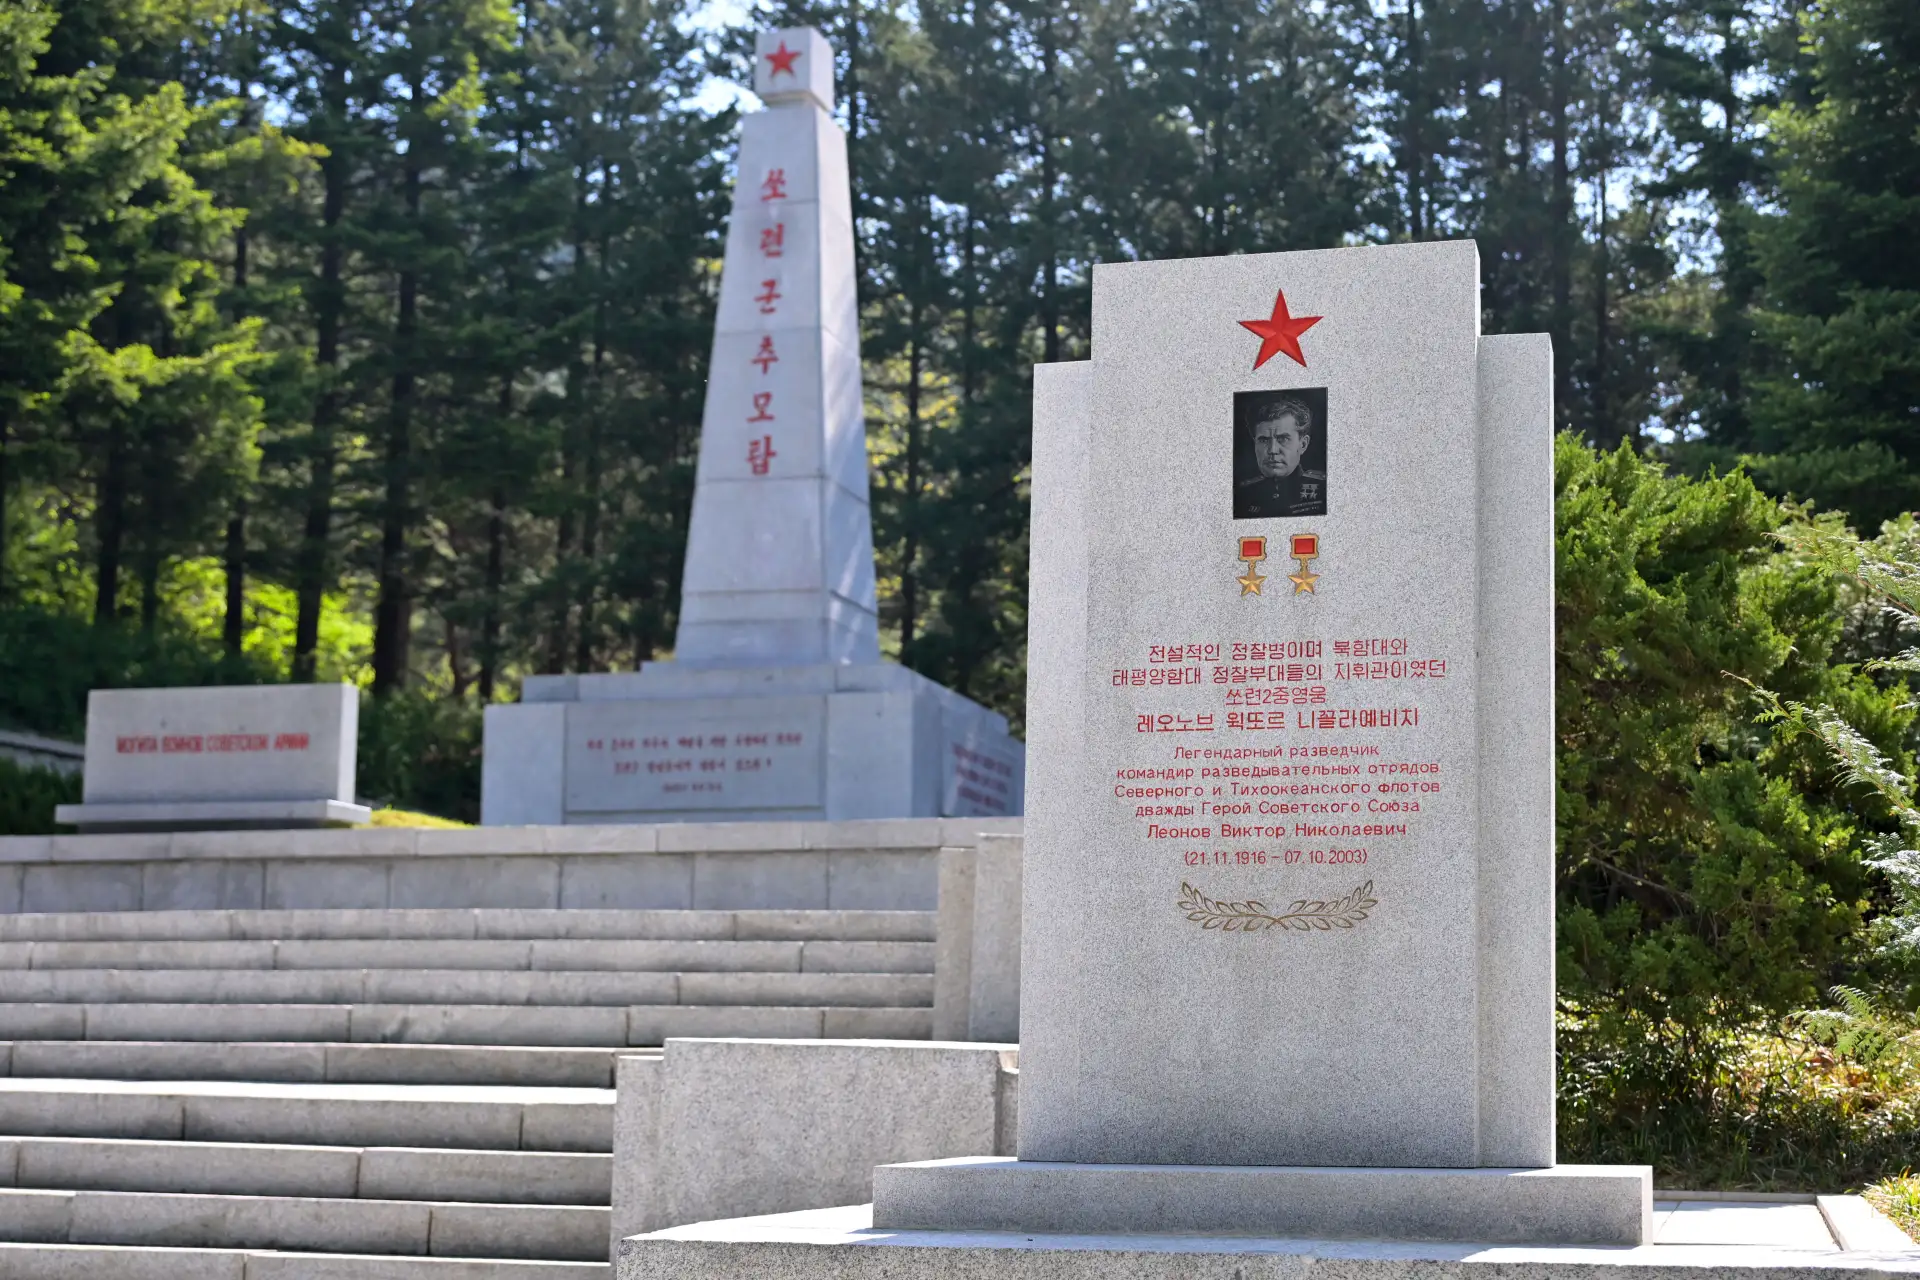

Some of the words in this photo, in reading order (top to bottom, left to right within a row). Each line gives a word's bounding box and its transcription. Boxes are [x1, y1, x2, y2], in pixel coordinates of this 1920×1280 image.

[1148, 643, 1220, 663] 전설적인
[1231, 639, 1322, 661] 정찰병이며
[1332, 637, 1408, 657] 북함대와
[1112, 666, 1201, 686] 태평양함대
[1212, 663, 1323, 686] 정찰부대들의
[1334, 658, 1446, 680] 지휘관이였던
[1224, 685, 1328, 706] 쏘련2중영웅
[1136, 712, 1214, 733] 레오노브
[1297, 707, 1419, 729] 니꼴라예비치
[1173, 745, 1283, 760] Легендарный
[1288, 745, 1379, 758] разведчик
[1116, 767, 1194, 780] командир
[1201, 764, 1360, 778] разведывательных
[1367, 762, 1440, 775] отрядов
[1114, 784, 1204, 798] Северного
[1211, 786, 1223, 795] и
[1231, 781, 1370, 795] Тихоокеанского
[1377, 781, 1440, 793] флотов
[1135, 804, 1194, 816] дважды
[1201, 800, 1252, 815] Герой
[1257, 799, 1360, 814] Советского
[1367, 798, 1420, 812] Союза
[1147, 823, 1211, 839] Леонов
[1220, 822, 1286, 839] Виктор
[1294, 823, 1407, 837] Николаевич
